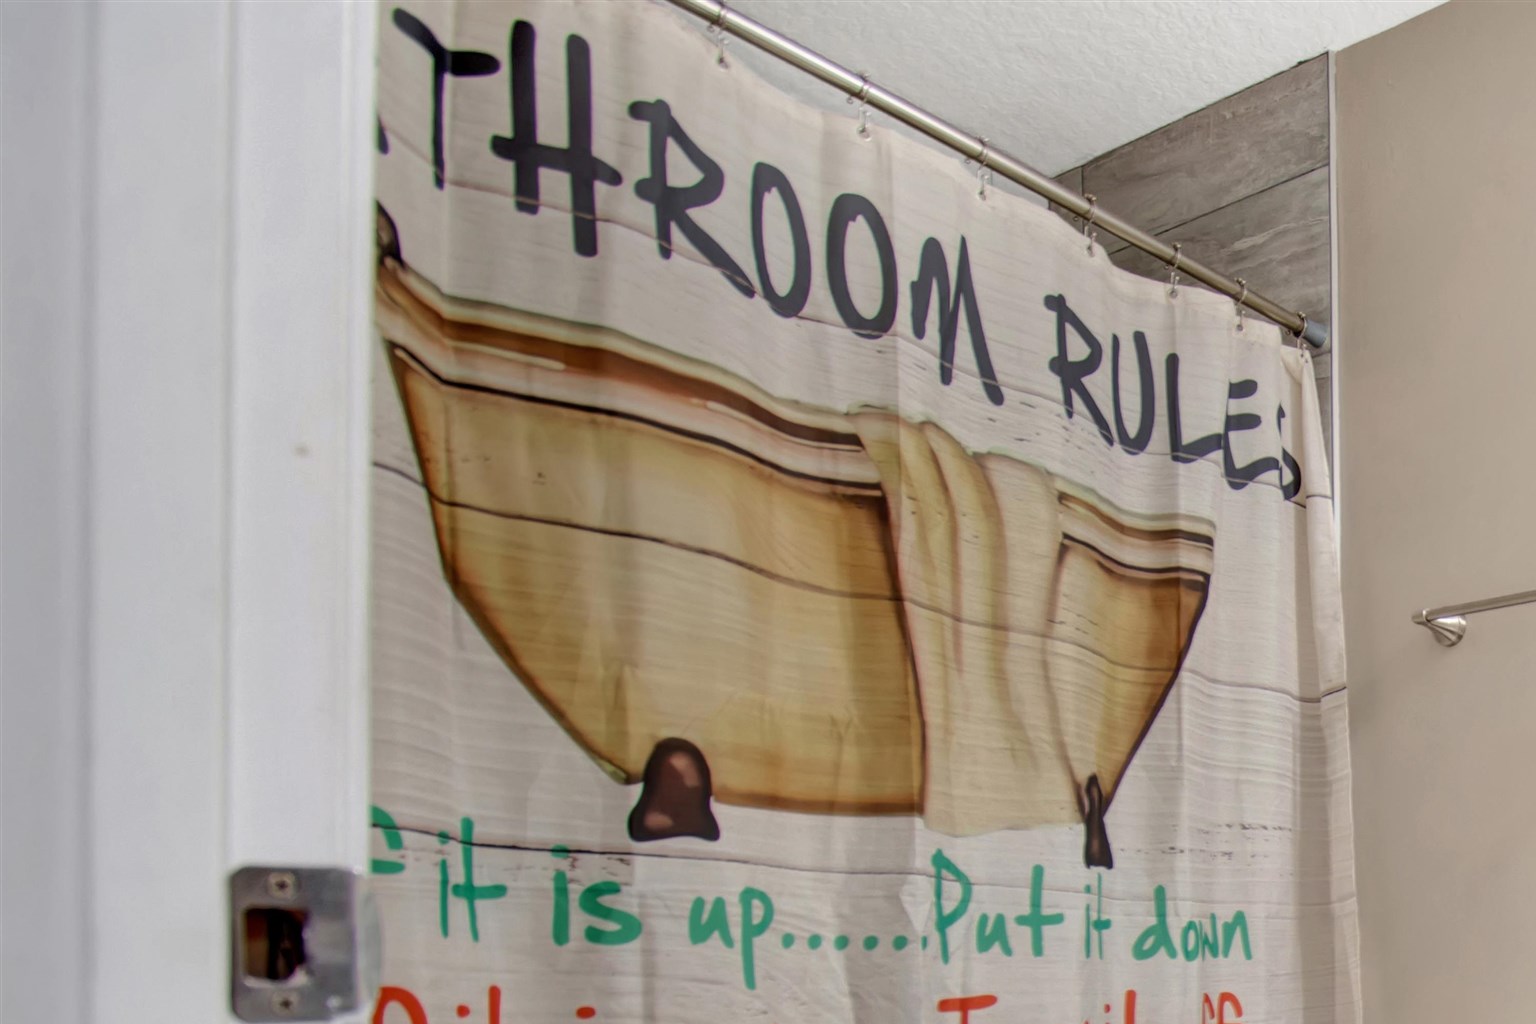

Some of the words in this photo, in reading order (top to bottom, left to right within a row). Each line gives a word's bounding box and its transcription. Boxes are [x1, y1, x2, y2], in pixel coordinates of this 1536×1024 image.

[376, 7, 1005, 407] THROOM
[438, 816, 508, 943] it
[551, 844, 643, 947] is
[1131, 884, 1253, 962] down
